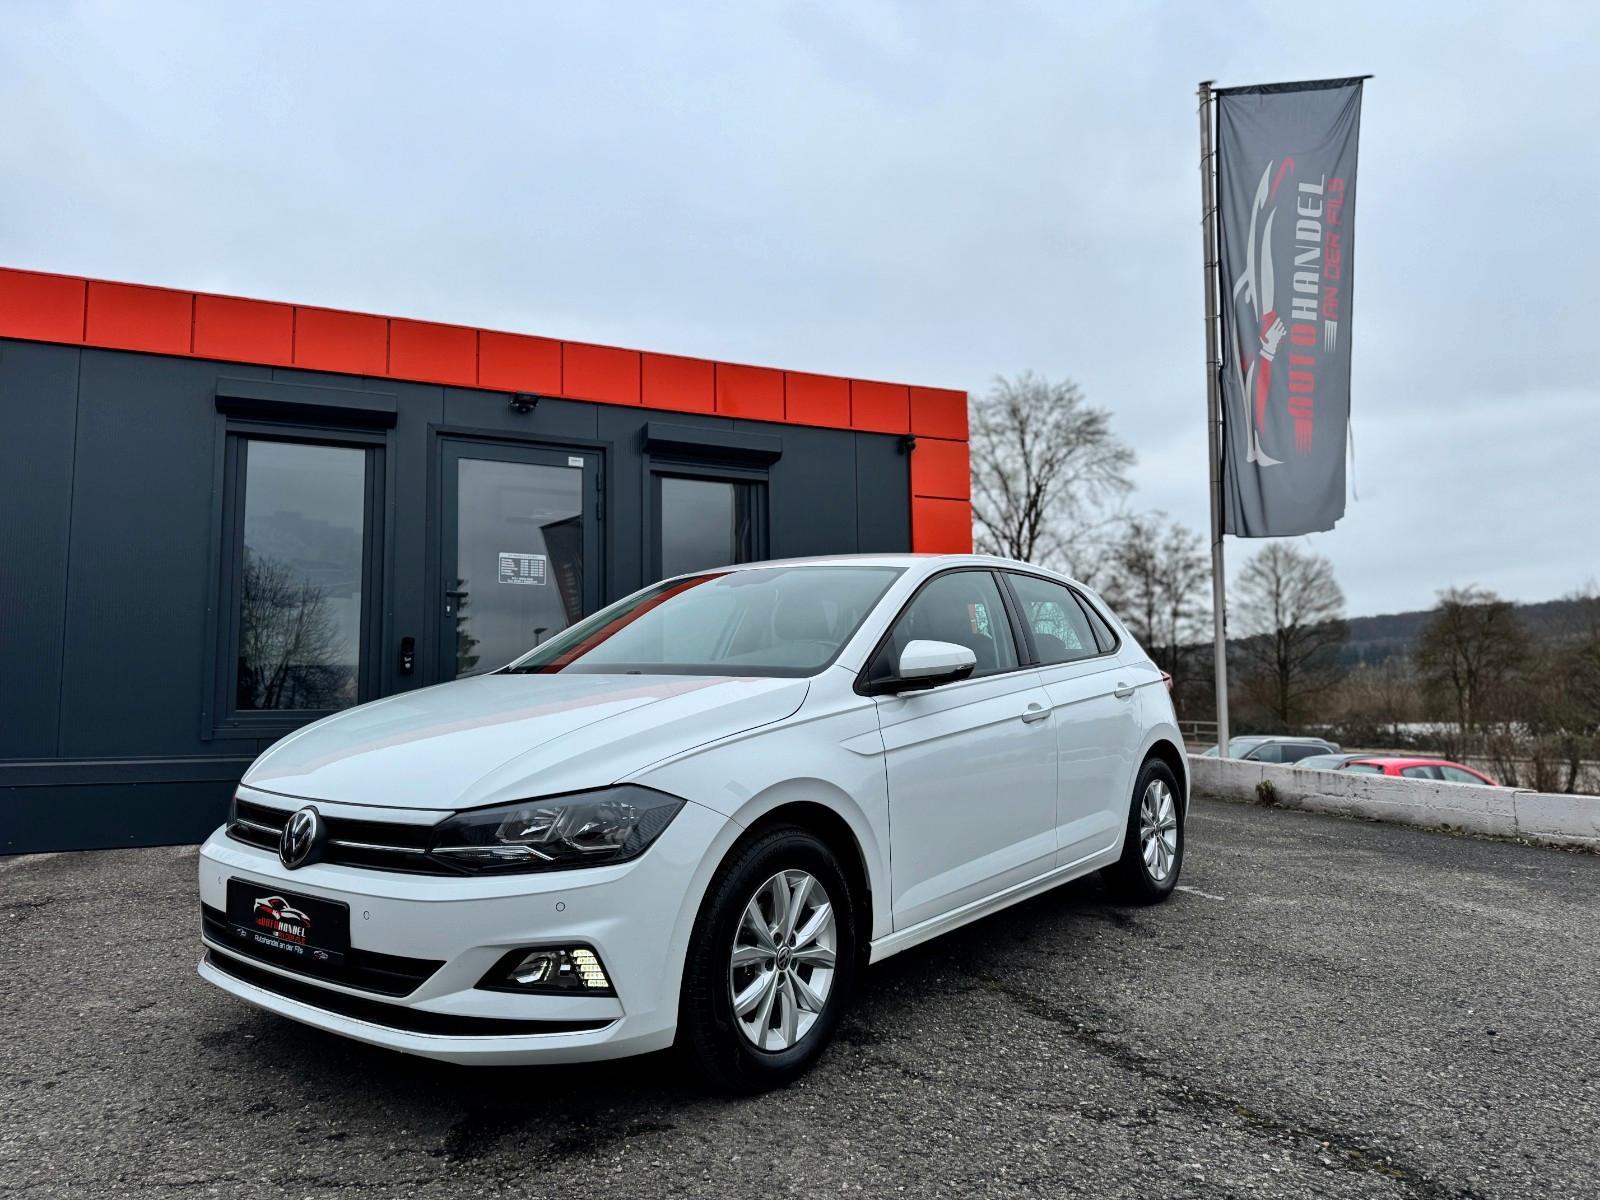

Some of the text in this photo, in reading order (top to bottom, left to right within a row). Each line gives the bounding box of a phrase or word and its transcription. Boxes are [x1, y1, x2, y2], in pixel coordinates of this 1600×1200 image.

[1289, 174, 1325, 417] AUTOHANDEL
[1322, 177, 1345, 320] AN DER FILS
